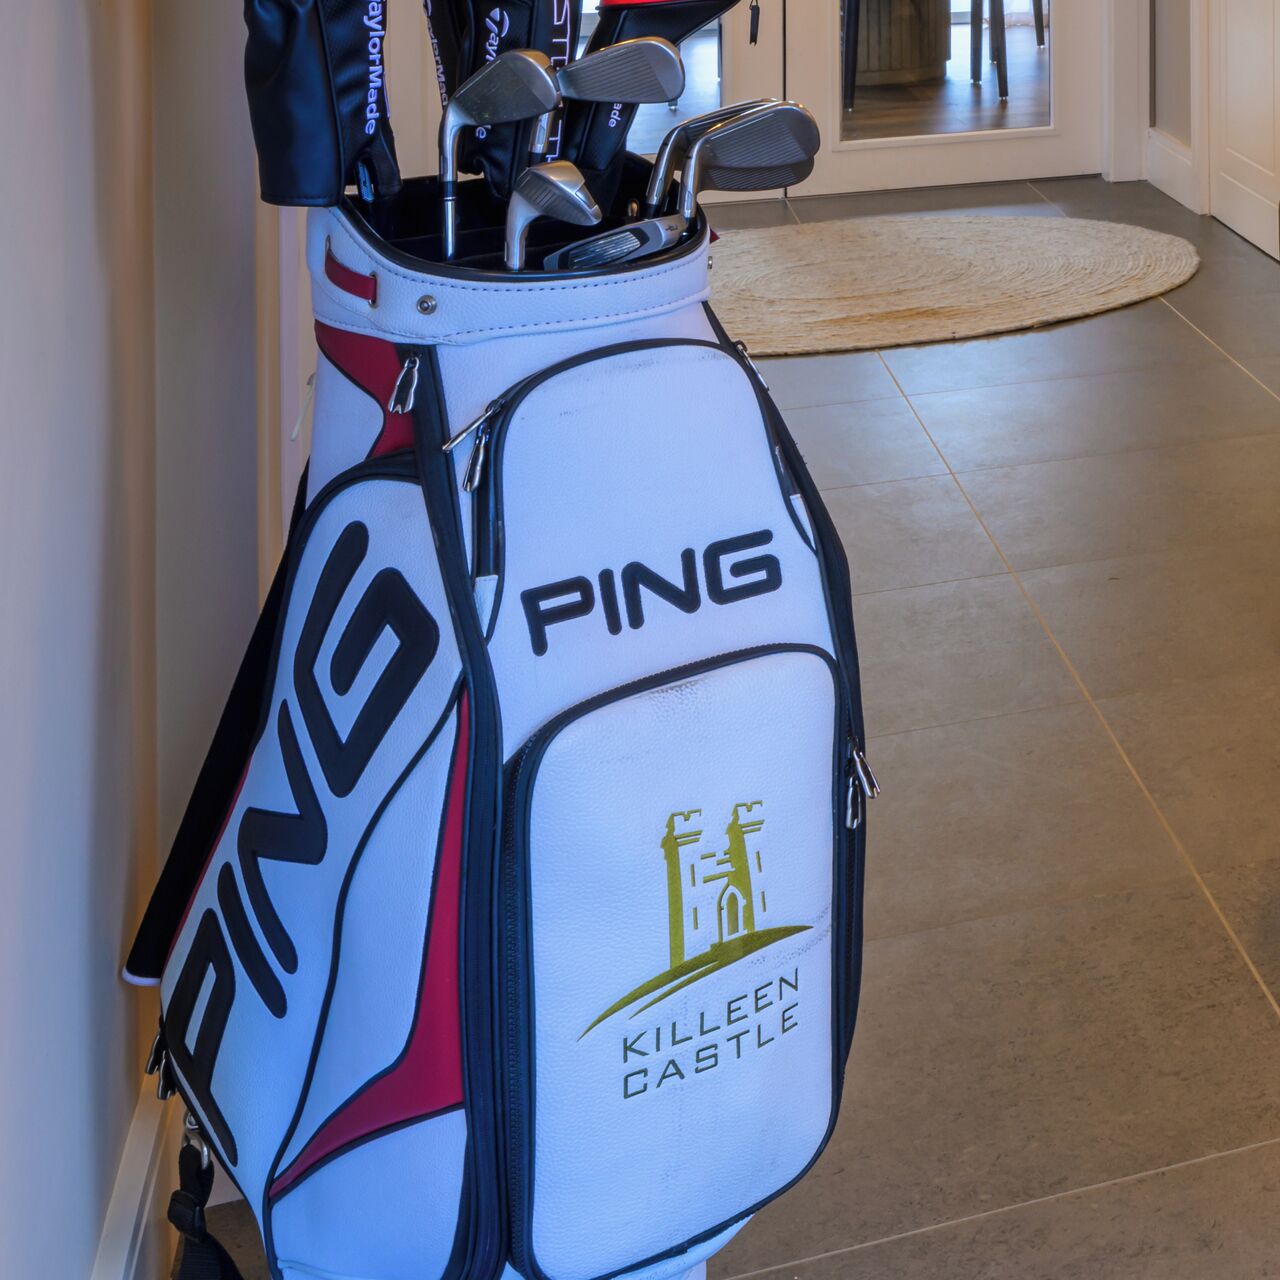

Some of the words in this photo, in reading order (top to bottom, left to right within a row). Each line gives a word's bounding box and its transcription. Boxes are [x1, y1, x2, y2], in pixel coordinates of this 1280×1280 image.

[520, 528, 783, 658] PING
[165, 520, 440, 1168] PING
[622, 967, 799, 1064] KILLEEN
[622, 1001, 799, 1100] CASTLE
